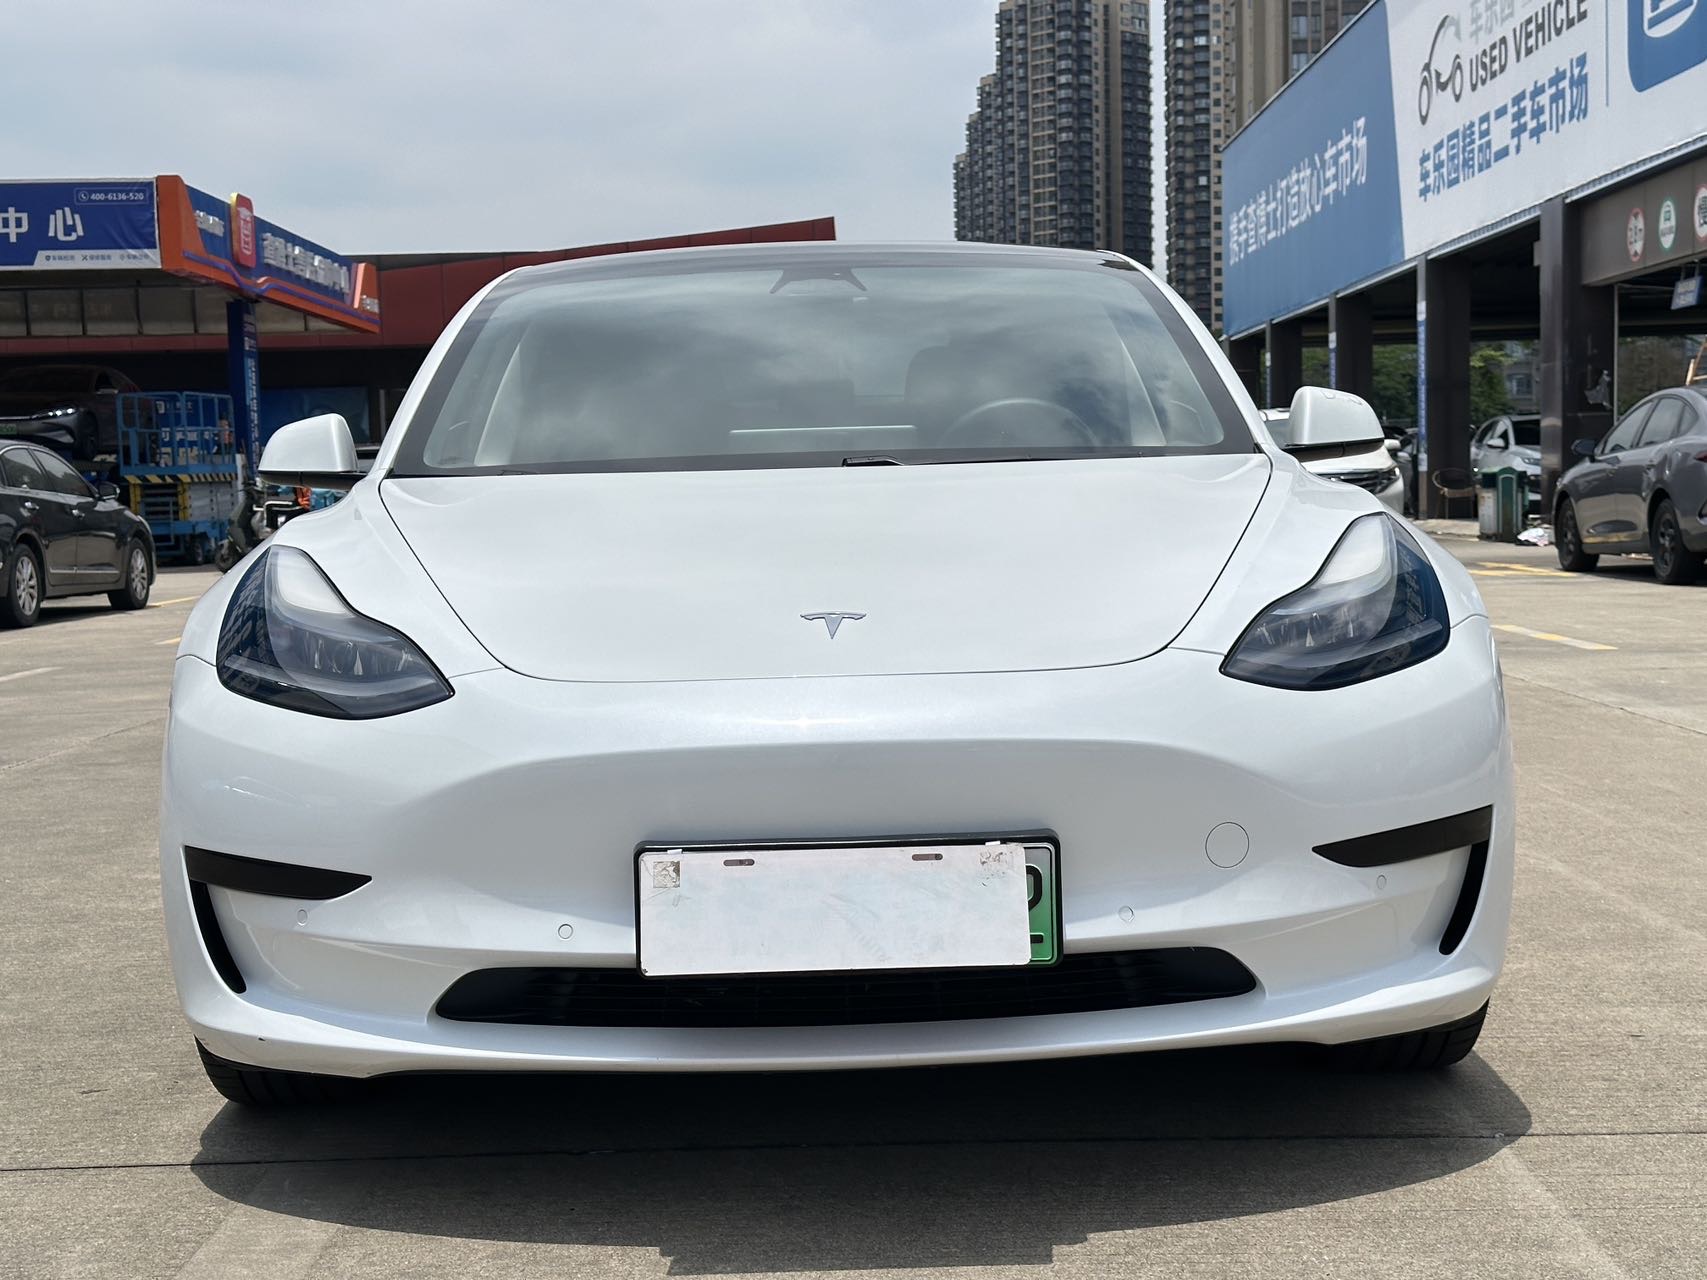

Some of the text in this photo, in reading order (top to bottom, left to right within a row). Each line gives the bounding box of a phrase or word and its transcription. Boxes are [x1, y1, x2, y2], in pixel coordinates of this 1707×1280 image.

[1469, 0, 1588, 92] USED VEHICLE
[1419, 51, 1588, 202] 车乐园精品二手车市场
[0, 206, 84, 243] 中心
[90, 192, 144, 201] 400-6136-520
